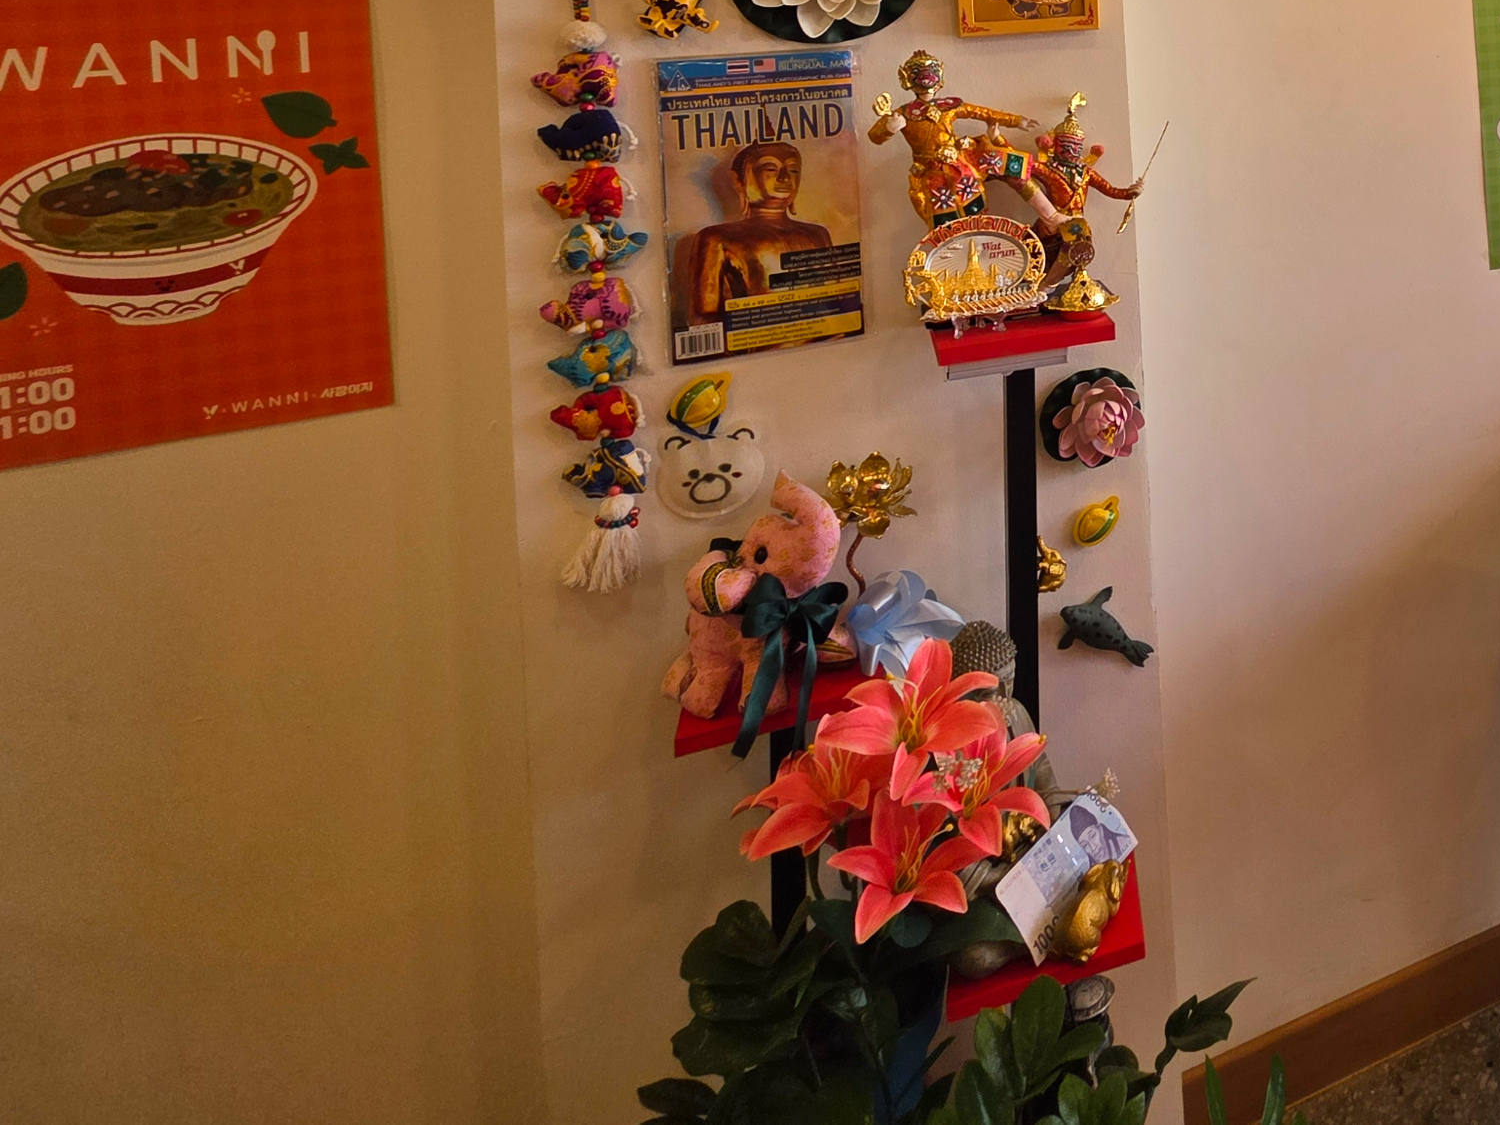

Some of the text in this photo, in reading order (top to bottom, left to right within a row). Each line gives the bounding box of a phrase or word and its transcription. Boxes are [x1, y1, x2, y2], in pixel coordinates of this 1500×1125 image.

[0, 30, 310, 92] WANNI
[778, 61, 827, 71] BILINGUAL
[667, 95, 731, 110] ประเทศไทย
[671, 103, 844, 150] THAILAND
[919, 215, 1030, 248] Thailand
[981, 242, 1001, 251] Wat
[231, 391, 308, 413] WANNI
